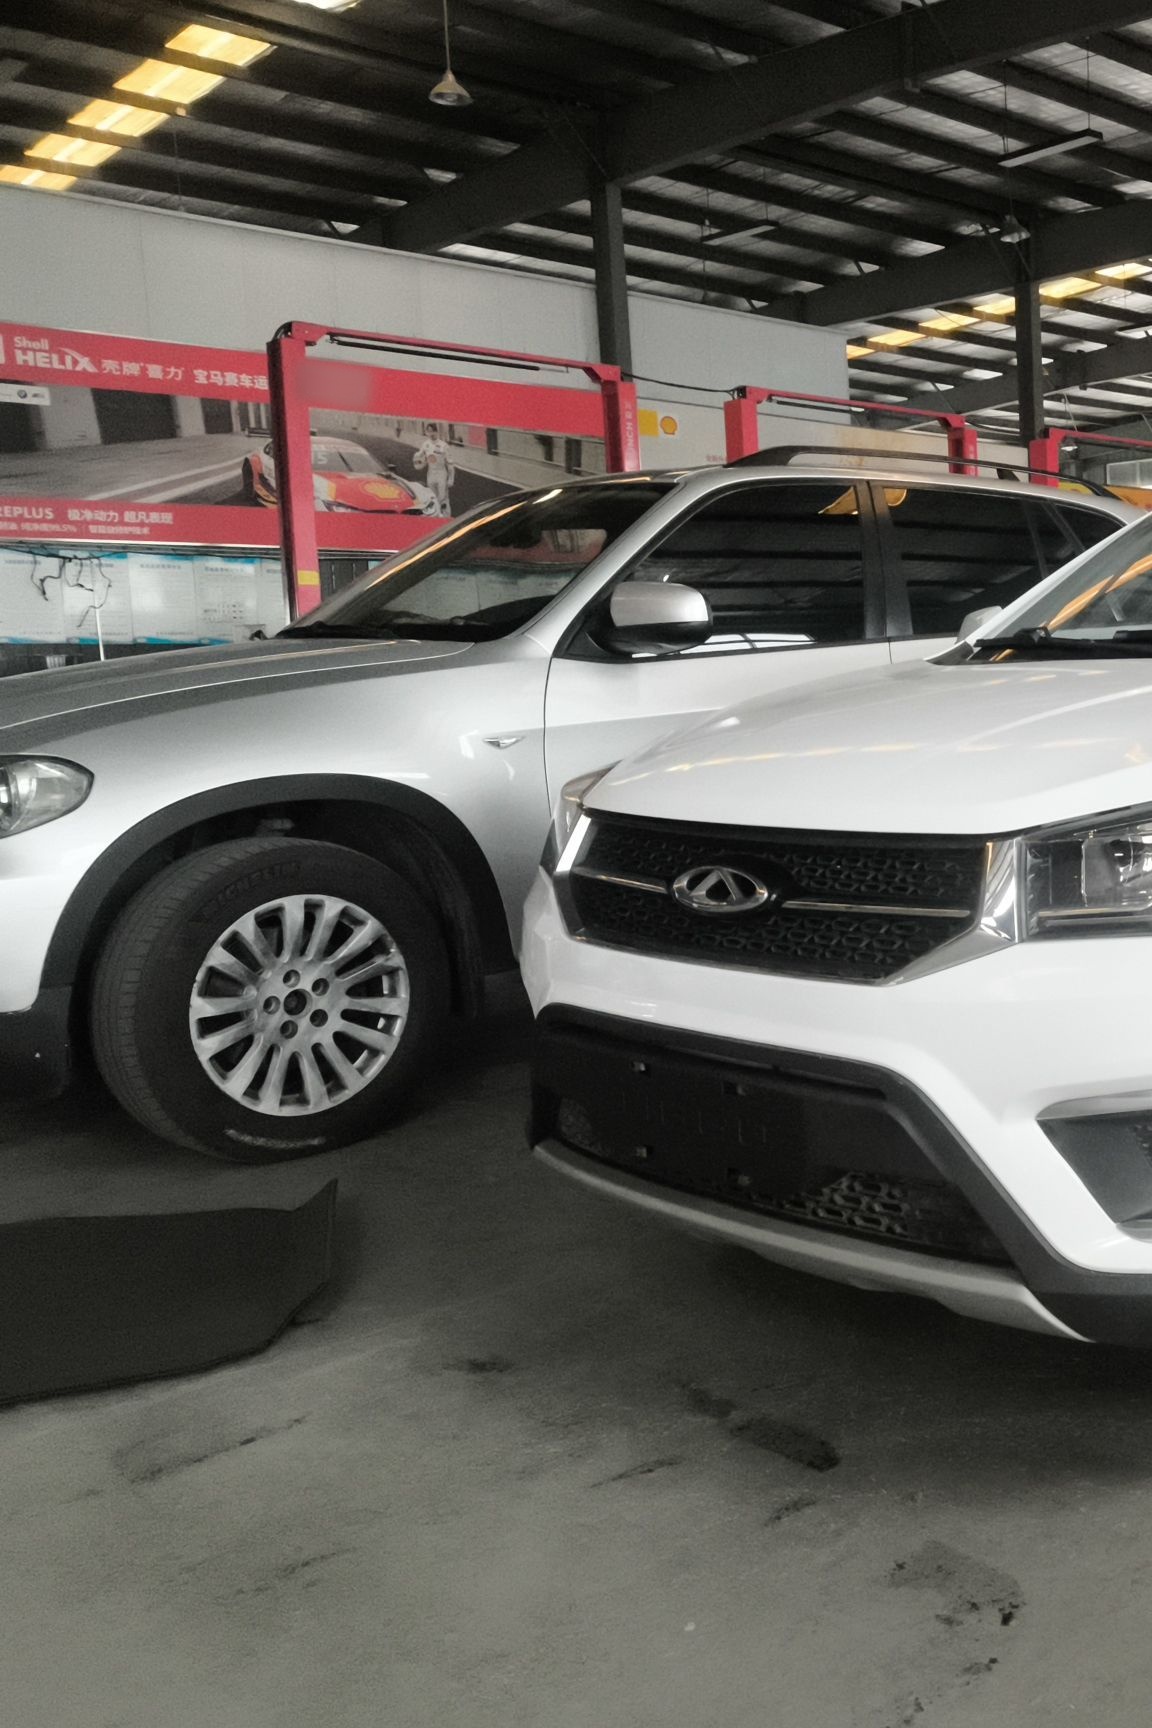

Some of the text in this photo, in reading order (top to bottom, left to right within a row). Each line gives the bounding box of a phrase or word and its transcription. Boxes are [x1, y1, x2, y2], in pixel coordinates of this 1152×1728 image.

[14, 336, 49, 351] Shell
[14, 347, 99, 373] HELIX
[0, 505, 55, 520] EPLUS
